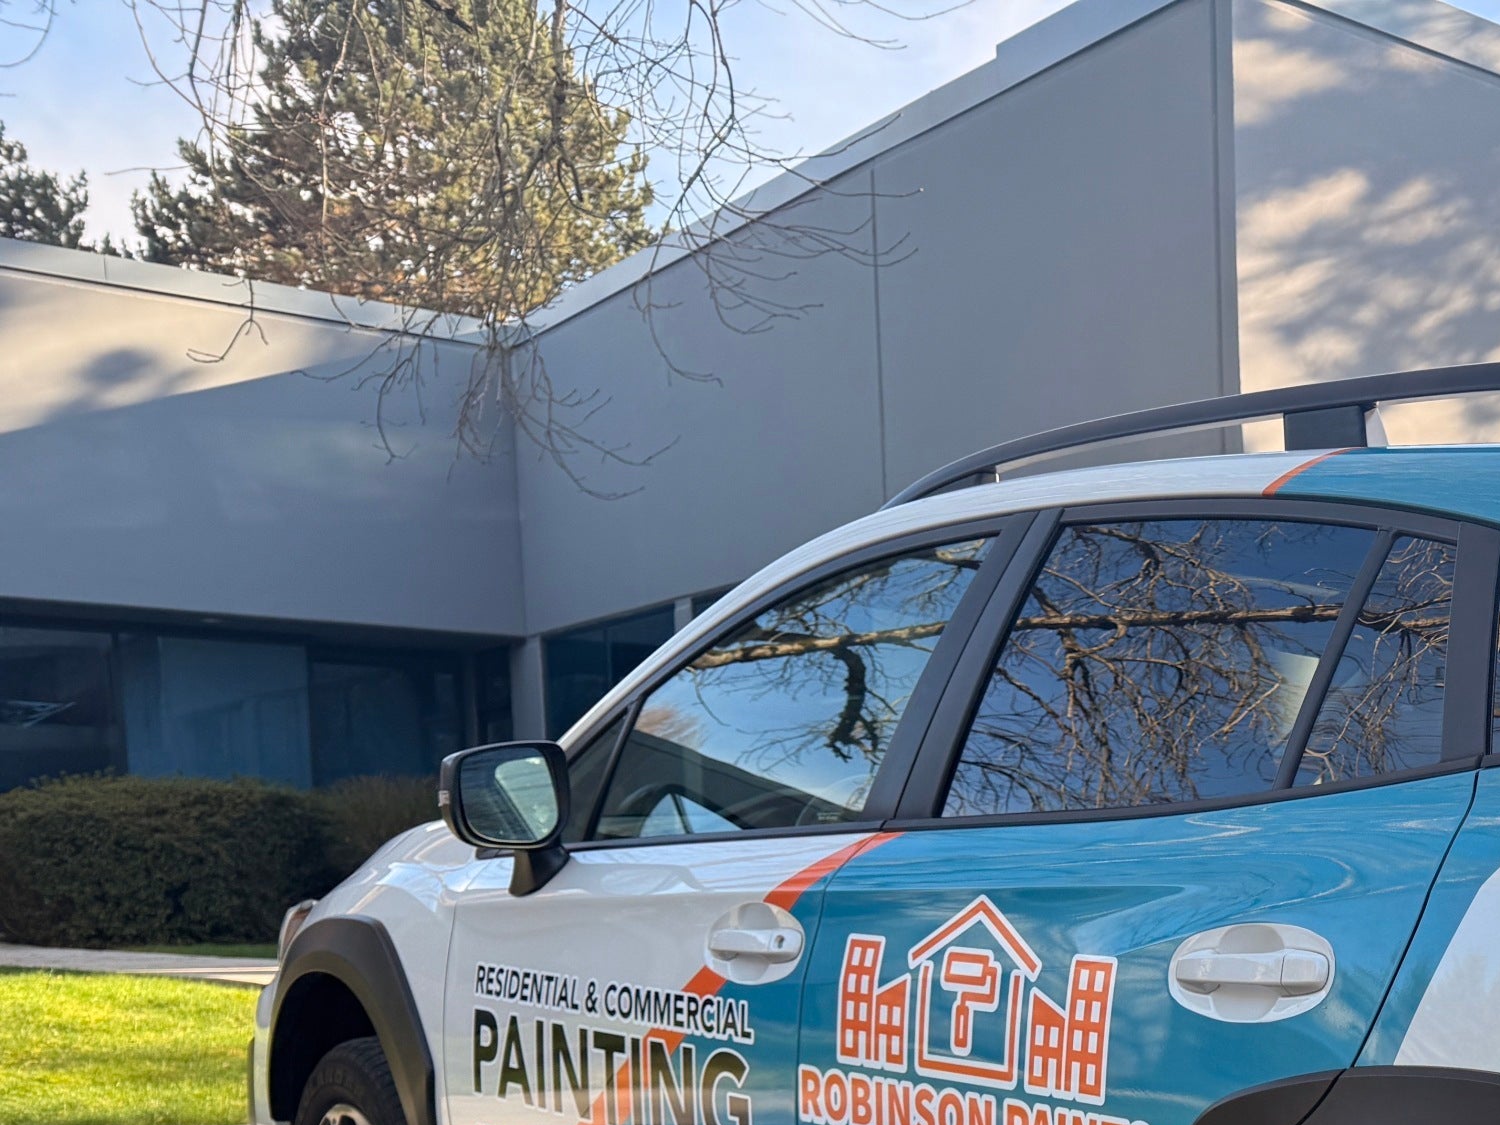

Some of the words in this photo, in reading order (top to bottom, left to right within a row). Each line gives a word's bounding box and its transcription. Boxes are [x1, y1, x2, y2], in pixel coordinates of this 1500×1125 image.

[476, 966, 579, 1011] RESIDENTIAL
[585, 981, 598, 1010] &
[604, 985, 753, 1040] COMMERCIAL
